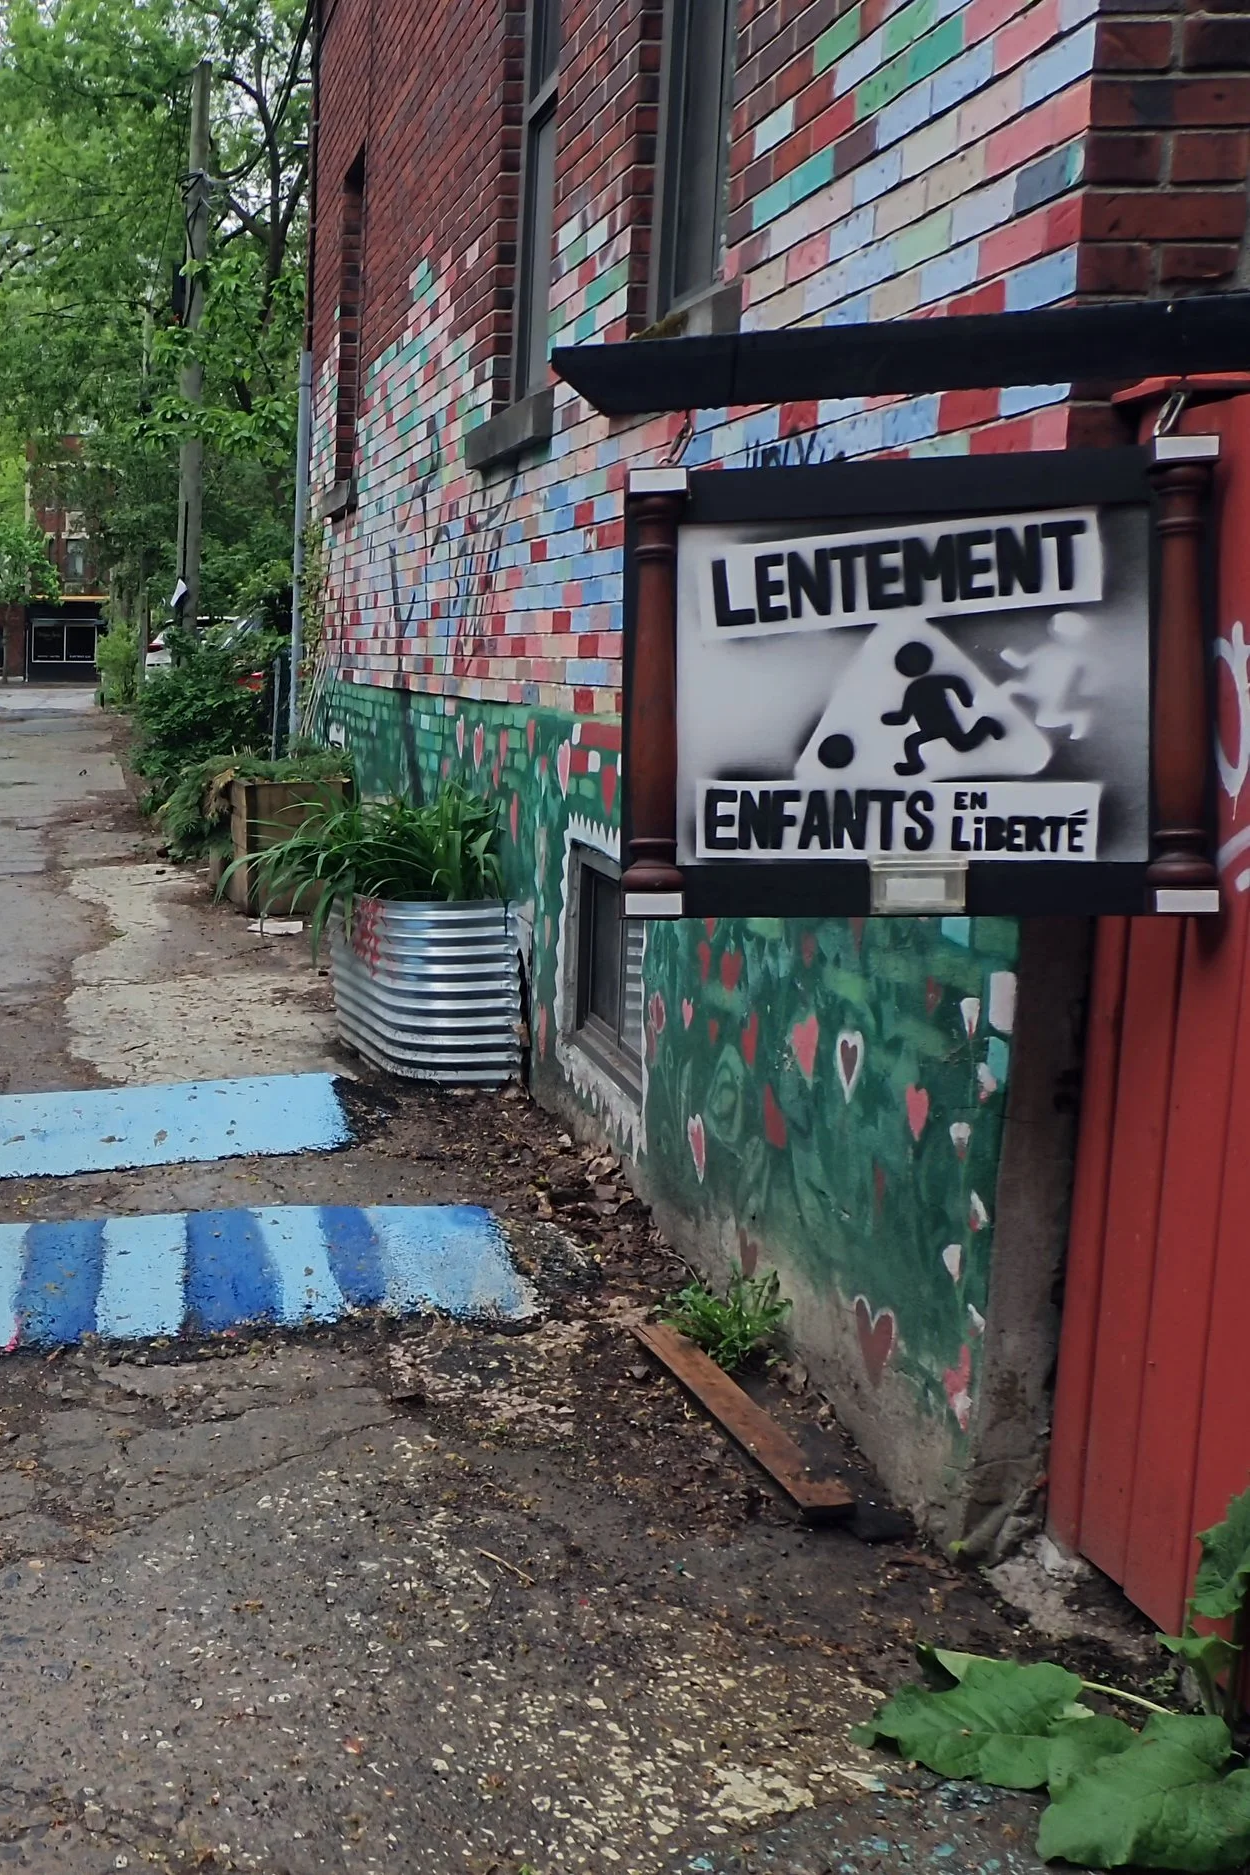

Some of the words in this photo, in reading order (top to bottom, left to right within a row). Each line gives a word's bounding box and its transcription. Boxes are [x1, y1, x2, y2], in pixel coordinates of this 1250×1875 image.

[711, 519, 1086, 627] LENTEMENT
[703, 788, 935, 852] ENFANTS
[953, 790, 988, 811] EN
